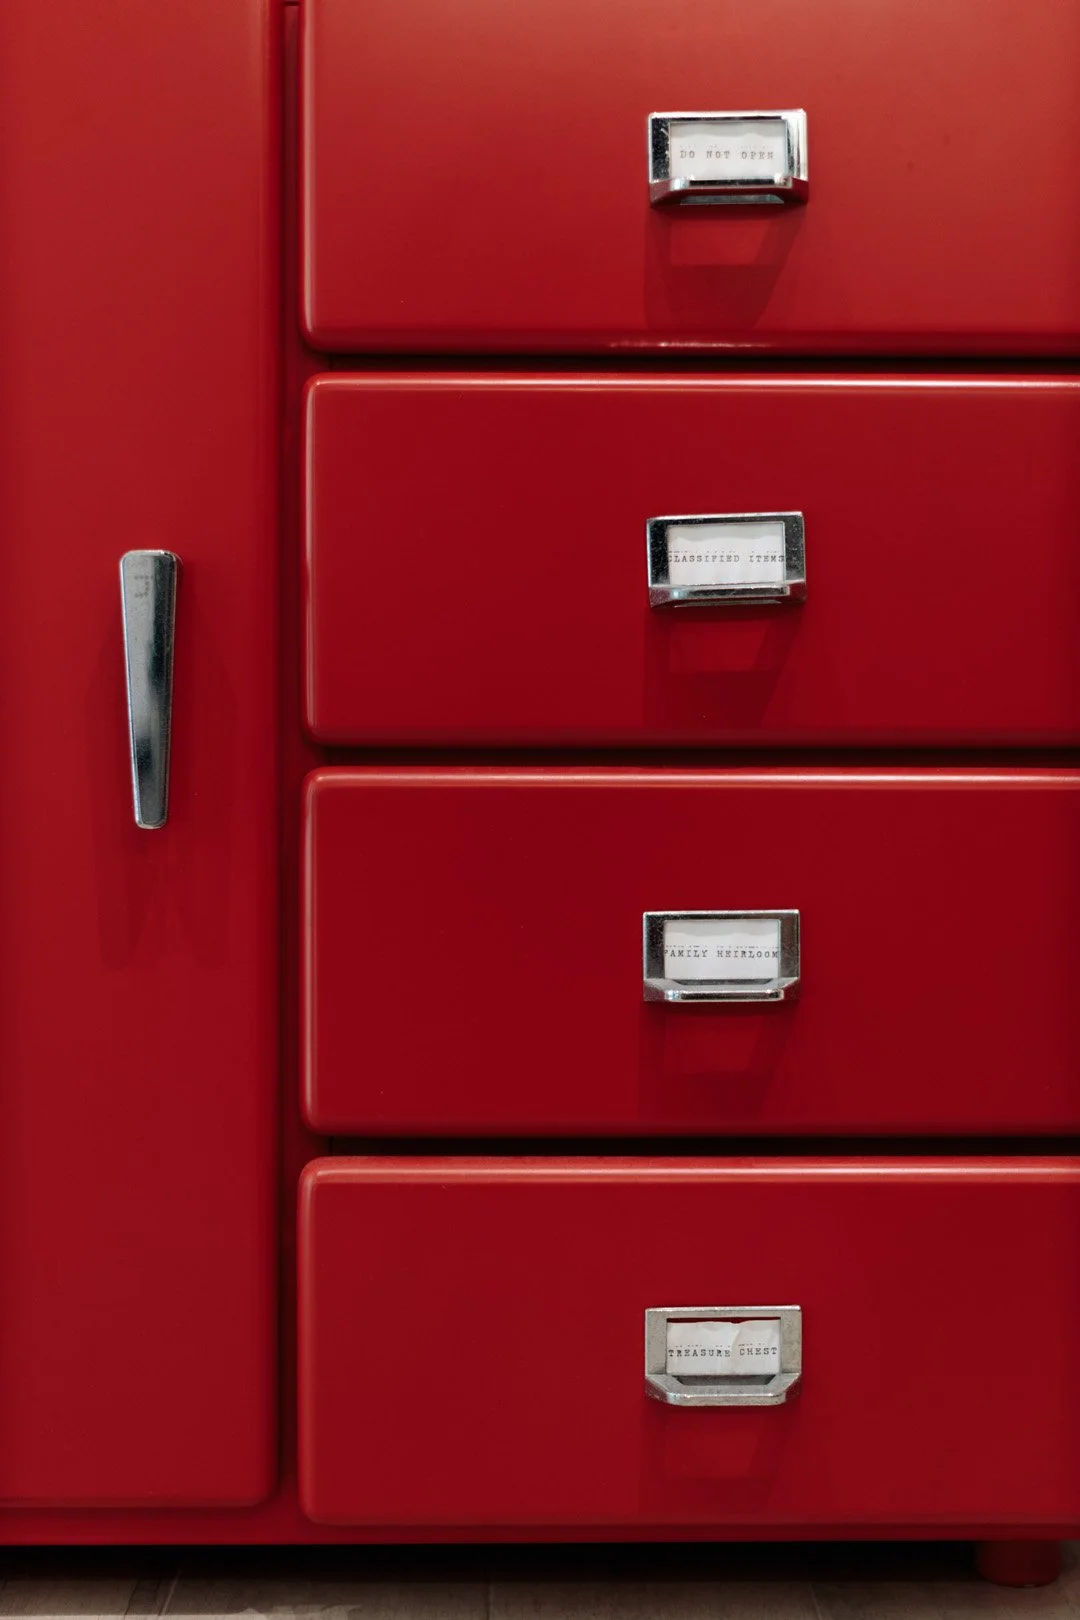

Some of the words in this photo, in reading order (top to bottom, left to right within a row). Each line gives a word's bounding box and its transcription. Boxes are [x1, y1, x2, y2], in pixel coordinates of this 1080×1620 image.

[680, 150, 695, 159] DO
[706, 150, 730, 159] NOT
[741, 151, 774, 160] OPEN
[668, 1349, 731, 1357] TREASURE
[739, 1347, 778, 1356] CHEST
